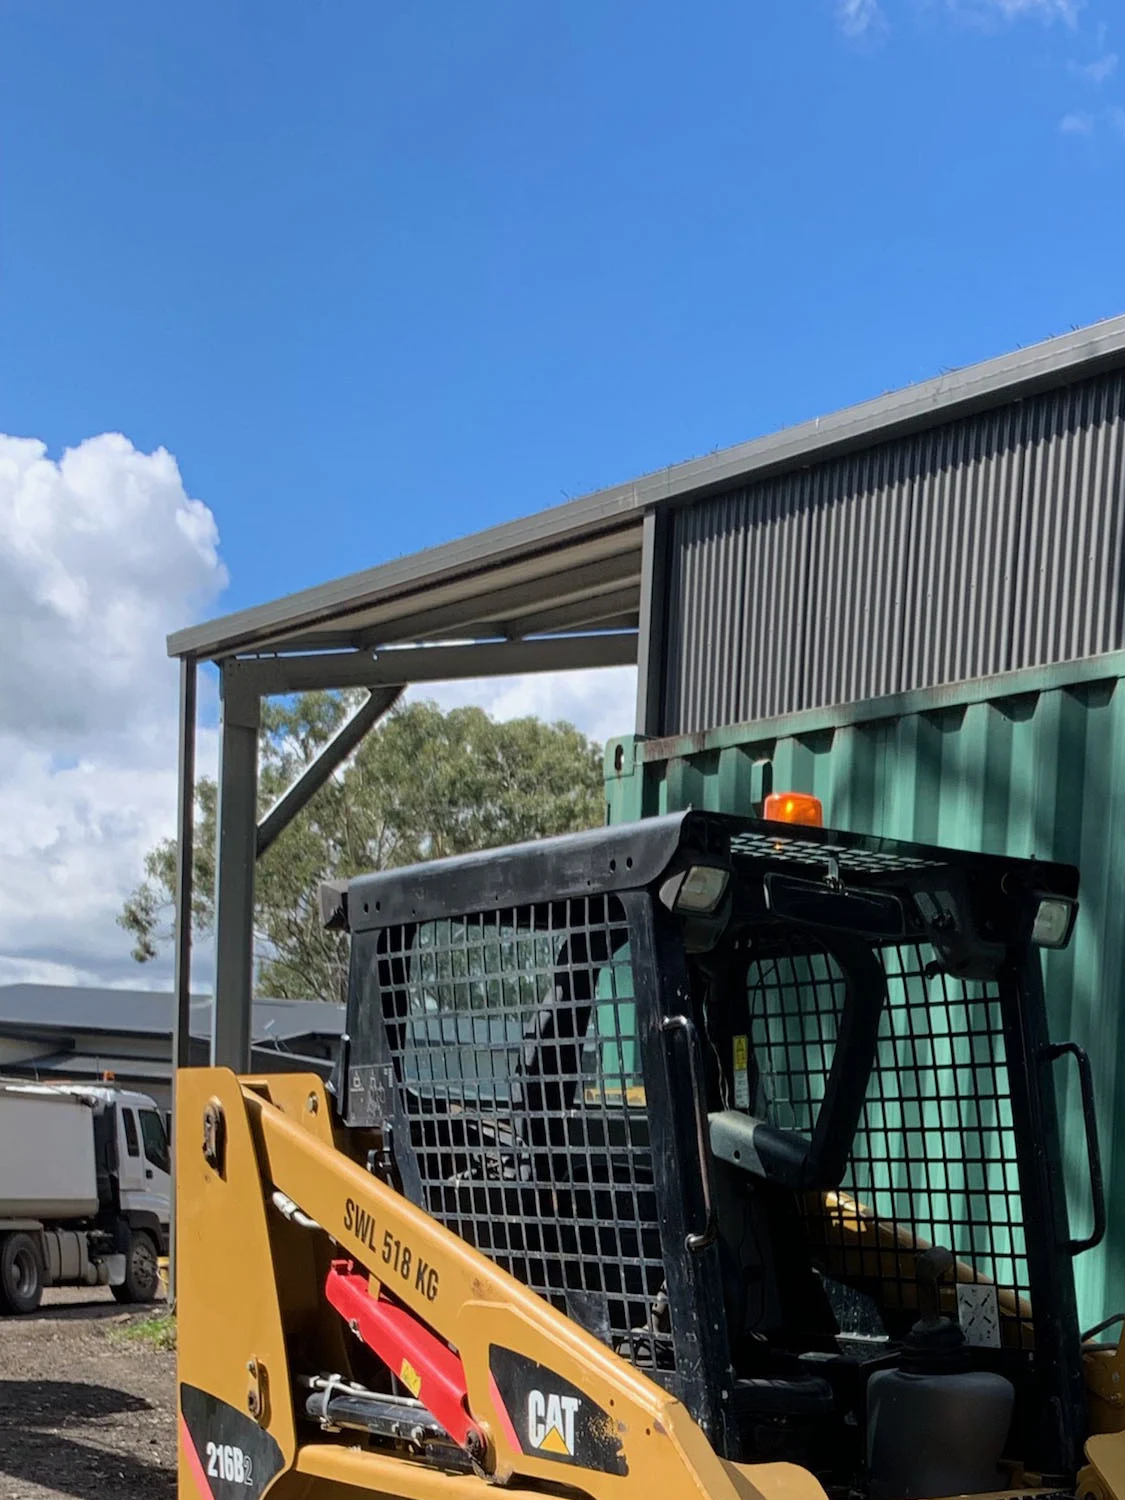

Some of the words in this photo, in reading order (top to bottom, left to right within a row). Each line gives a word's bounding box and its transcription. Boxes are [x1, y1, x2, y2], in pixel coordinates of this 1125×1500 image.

[343, 1197, 376, 1254] SWL
[382, 1230, 411, 1281] 518
[415, 1262, 440, 1302] KG
[527, 1389, 580, 1456] CAT
